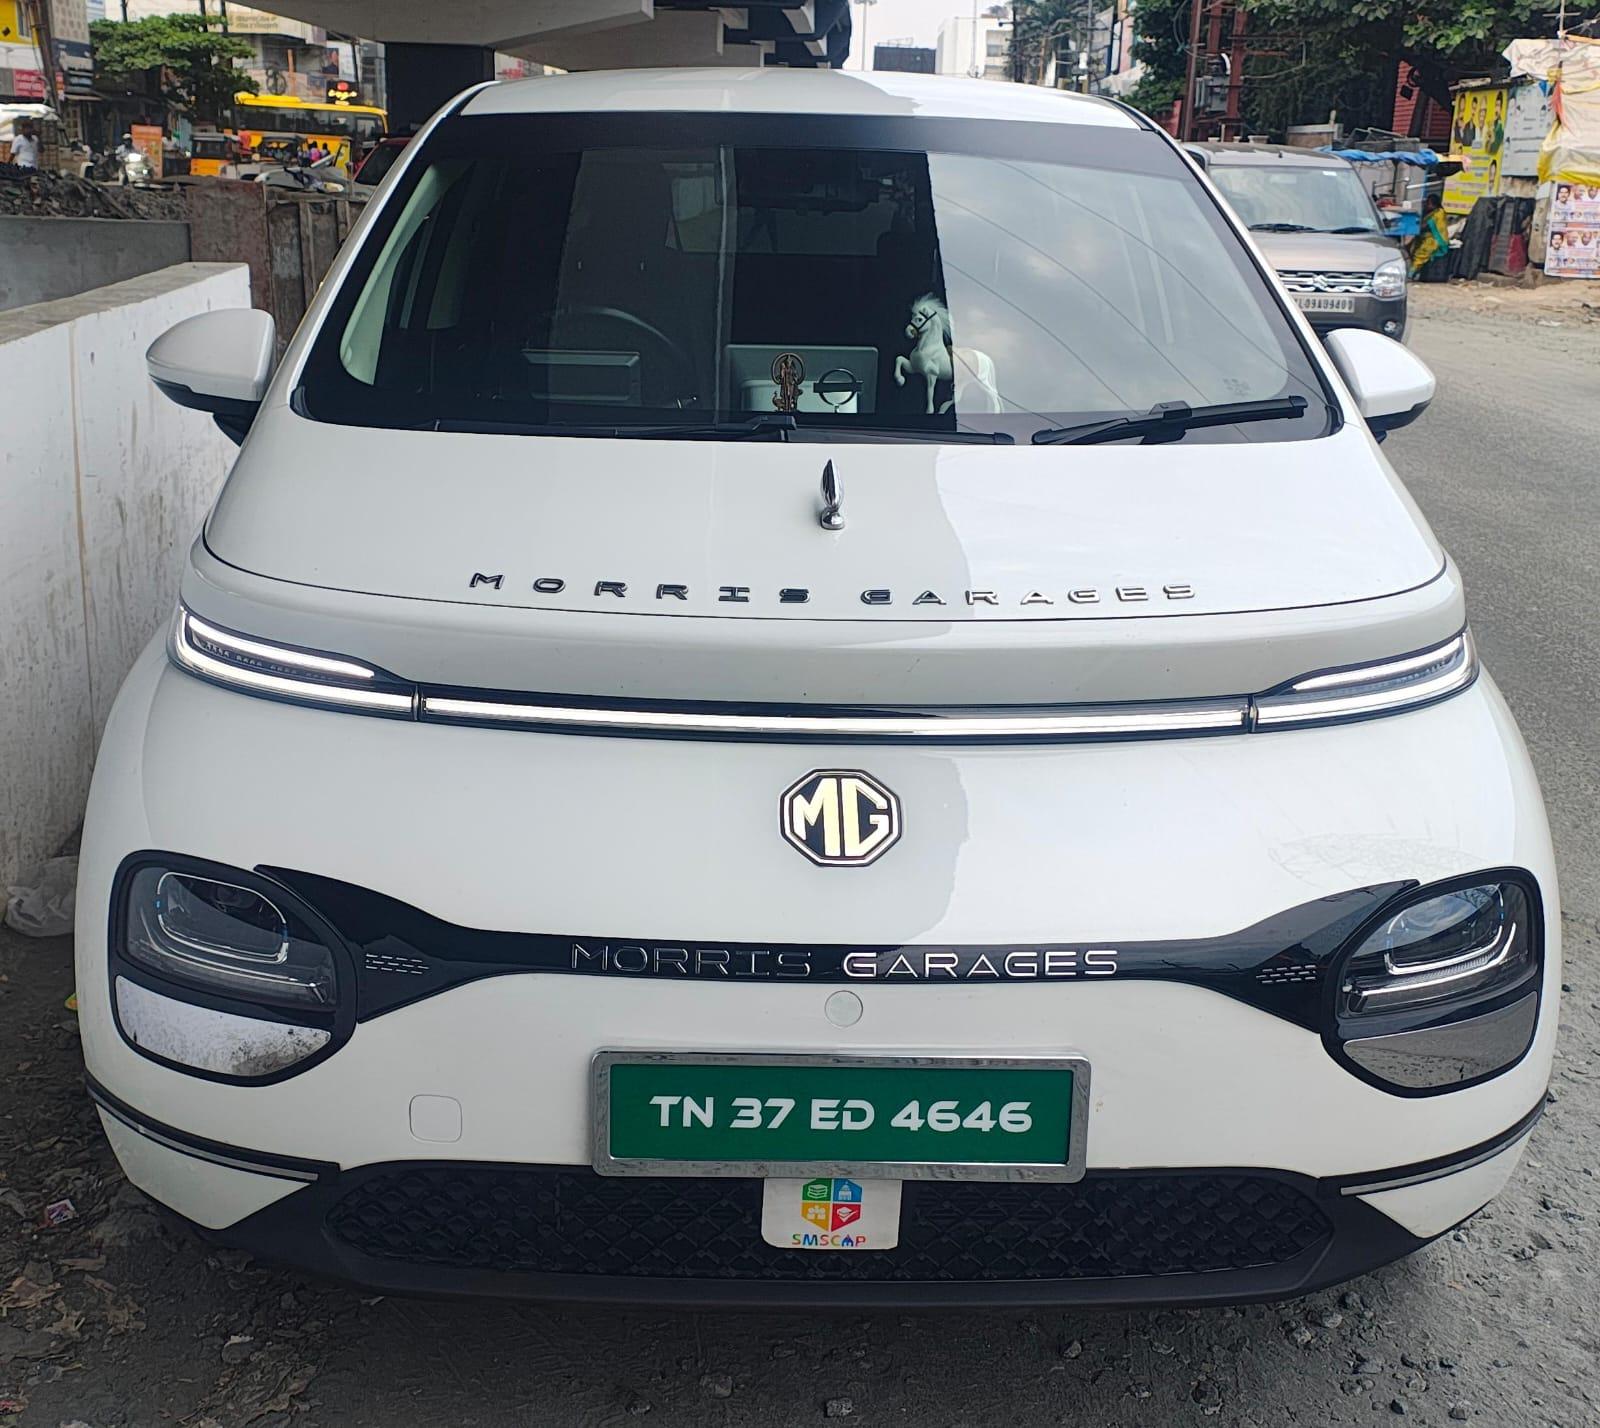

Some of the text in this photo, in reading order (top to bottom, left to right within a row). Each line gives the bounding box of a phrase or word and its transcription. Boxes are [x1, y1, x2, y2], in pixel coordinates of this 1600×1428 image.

[469, 572, 1197, 606] MORRIS GARAGES
[792, 777, 890, 858] MG
[571, 943, 1119, 978] MORRIS GARAGES
[649, 1095, 1033, 1133] TN 37 ED 4646
